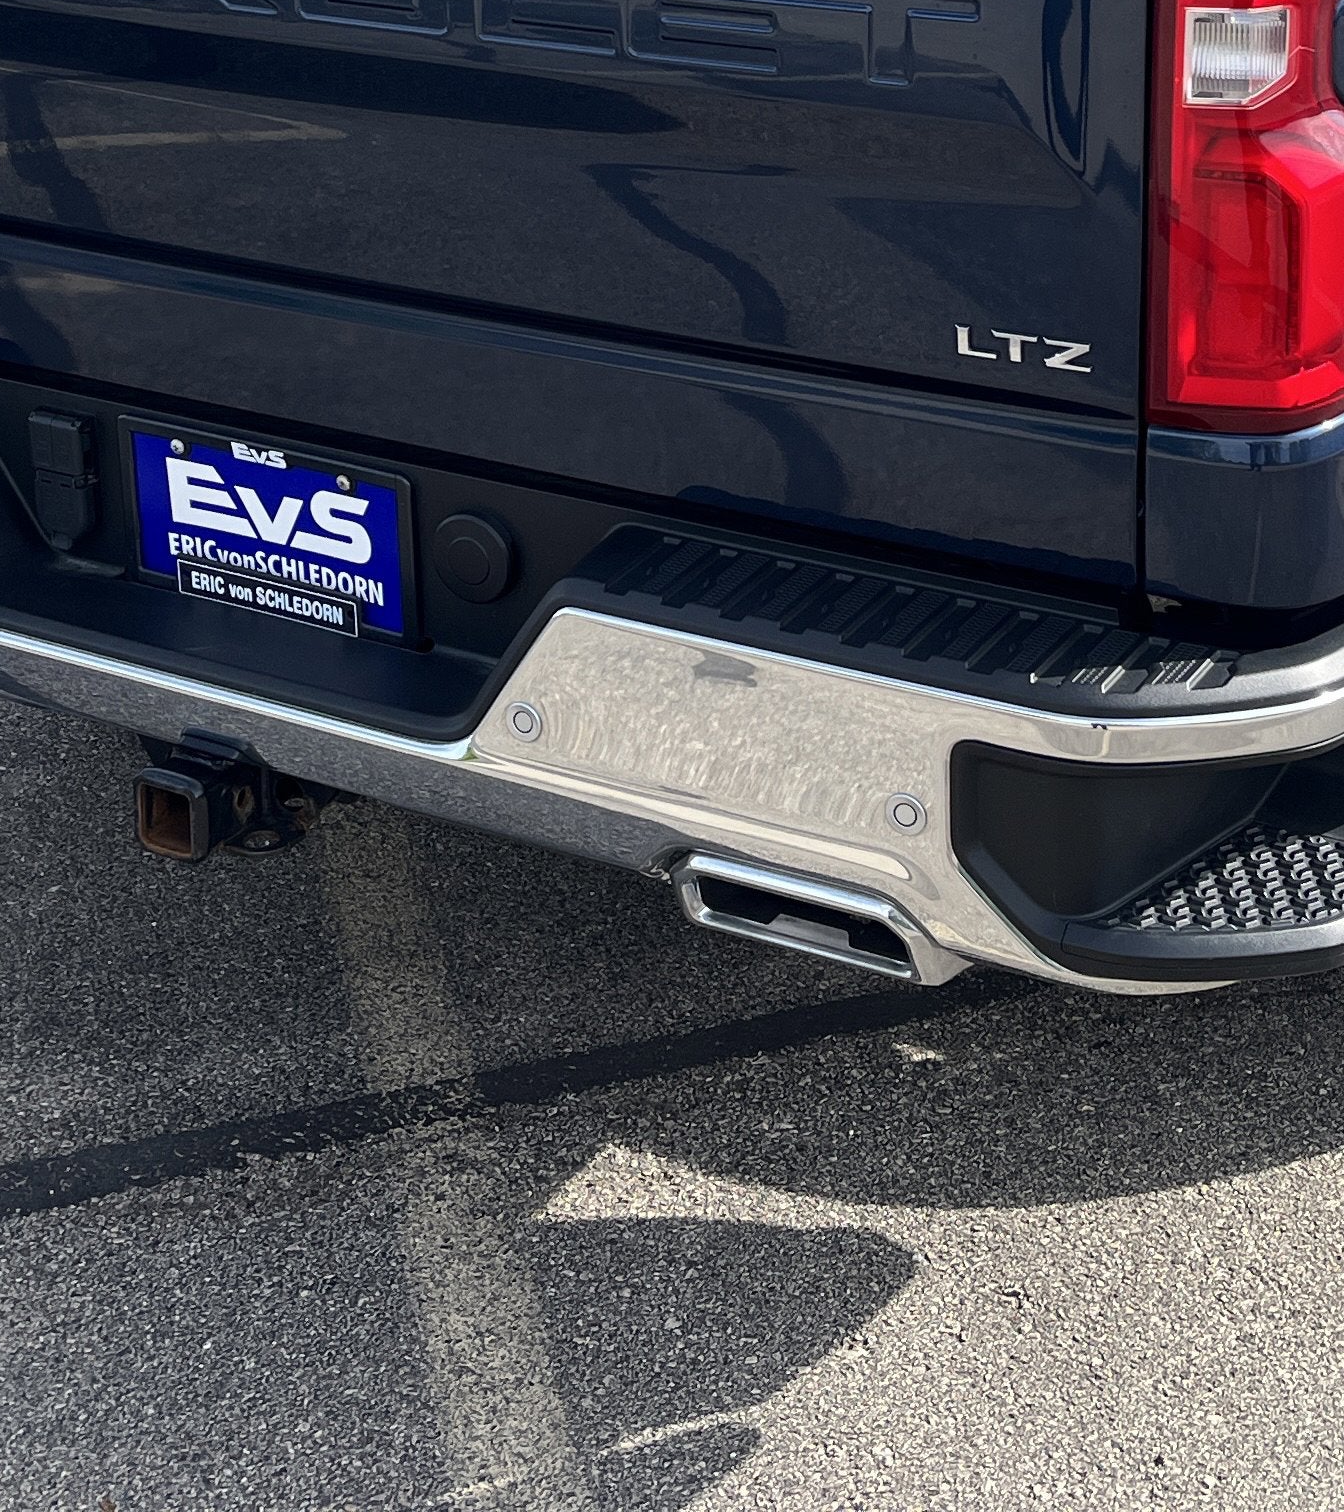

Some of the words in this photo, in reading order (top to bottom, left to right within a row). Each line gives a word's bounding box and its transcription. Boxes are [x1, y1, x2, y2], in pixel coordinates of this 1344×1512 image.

[954, 324, 1094, 374] LTZ
[191, 571, 225, 595] ERIC
[229, 583, 253, 603] von
[256, 587, 344, 626] SCHLEDORN
